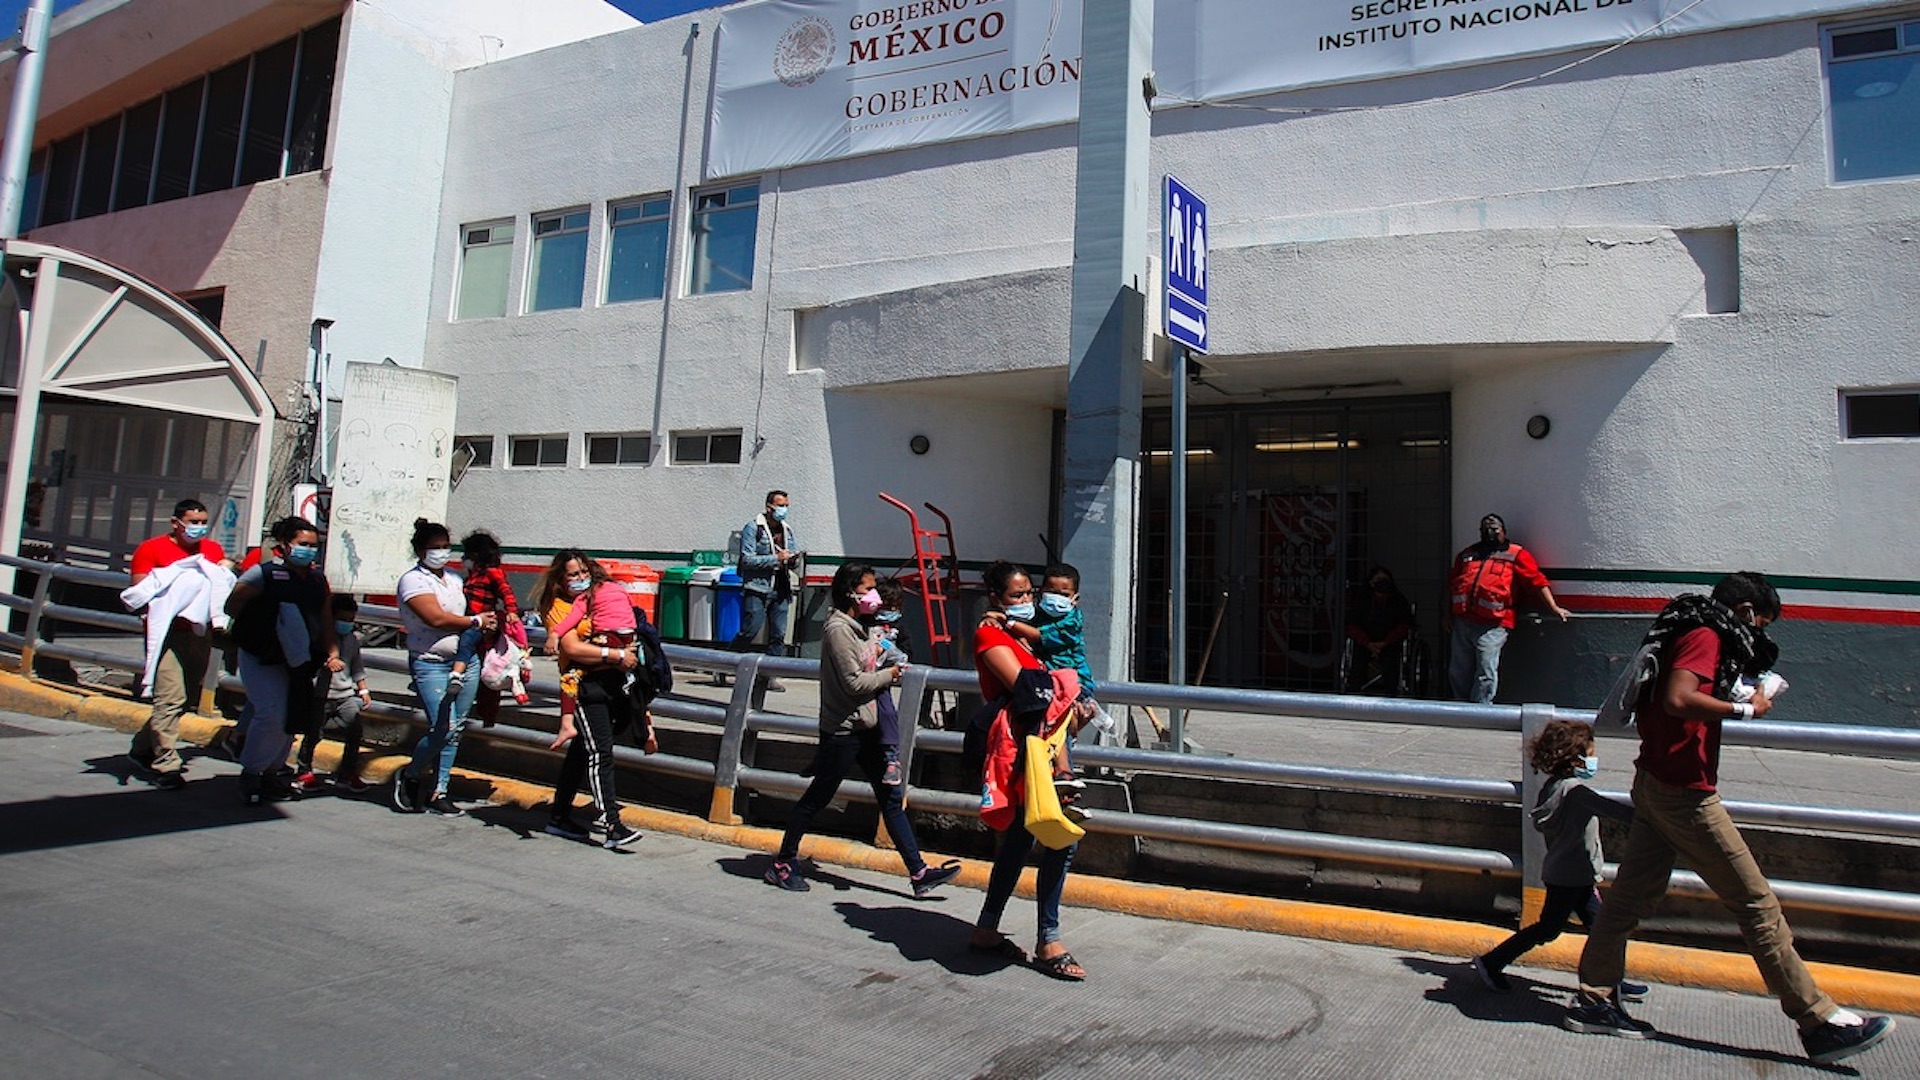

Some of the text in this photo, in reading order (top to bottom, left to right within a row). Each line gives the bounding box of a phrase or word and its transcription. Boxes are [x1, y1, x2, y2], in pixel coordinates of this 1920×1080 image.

[847, 12, 1005, 66] MÉXICO
[850, 0, 968, 30] GOBIERNO
[1319, 18, 1441, 51] INSTITUTO
[1450, 0, 1588, 31] NACIONAL
[845, 54, 1082, 119] GOBERNACIÓN
